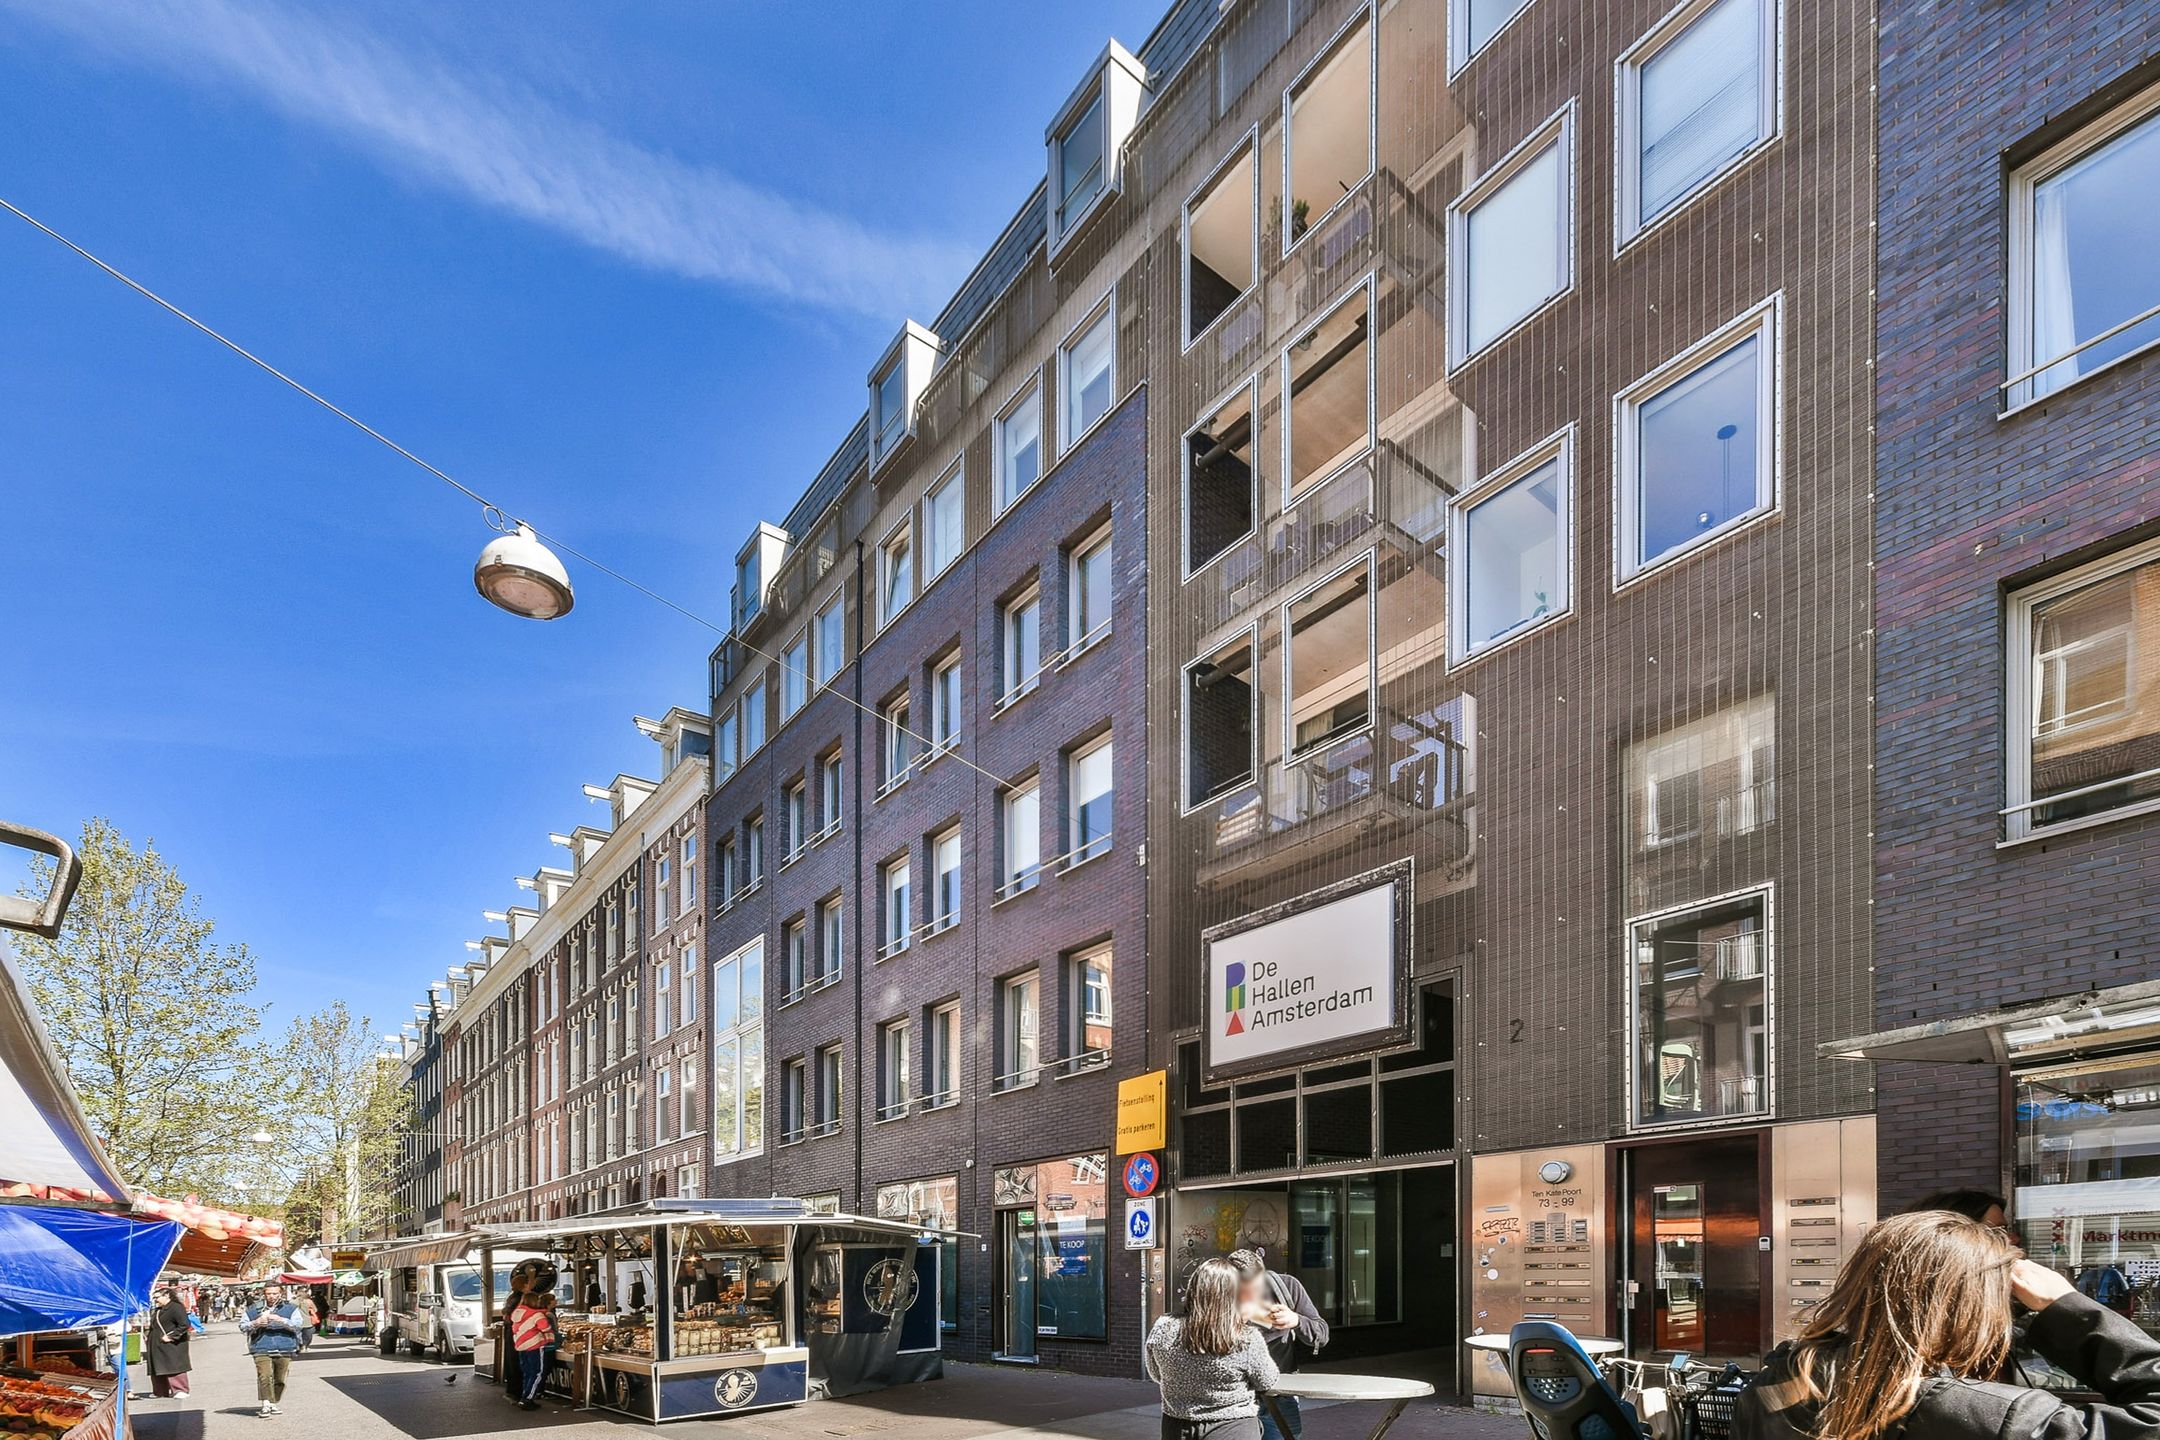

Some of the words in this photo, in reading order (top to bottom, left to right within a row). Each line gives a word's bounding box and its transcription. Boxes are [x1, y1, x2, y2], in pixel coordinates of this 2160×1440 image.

[1252, 961, 1278, 982] De
[1252, 975, 1315, 1006] Hallen
[1251, 986, 1373, 1031] Amsterdam
[1510, 1017, 1524, 1044] 2
[1119, 1094, 1155, 1107] Fietsenstalling
[1118, 1127, 1132, 1135] Gratis
[1133, 1123, 1155, 1134] parkeren
[1546, 1189, 1561, 1197] Kate
[1562, 1188, 1582, 1196] Poort
[1539, 1198, 1550, 1207] 73
[1561, 1197, 1575, 1206] 99
[1059, 1241, 1067, 1249] TE
[1067, 1240, 1085, 1249] KOOP
